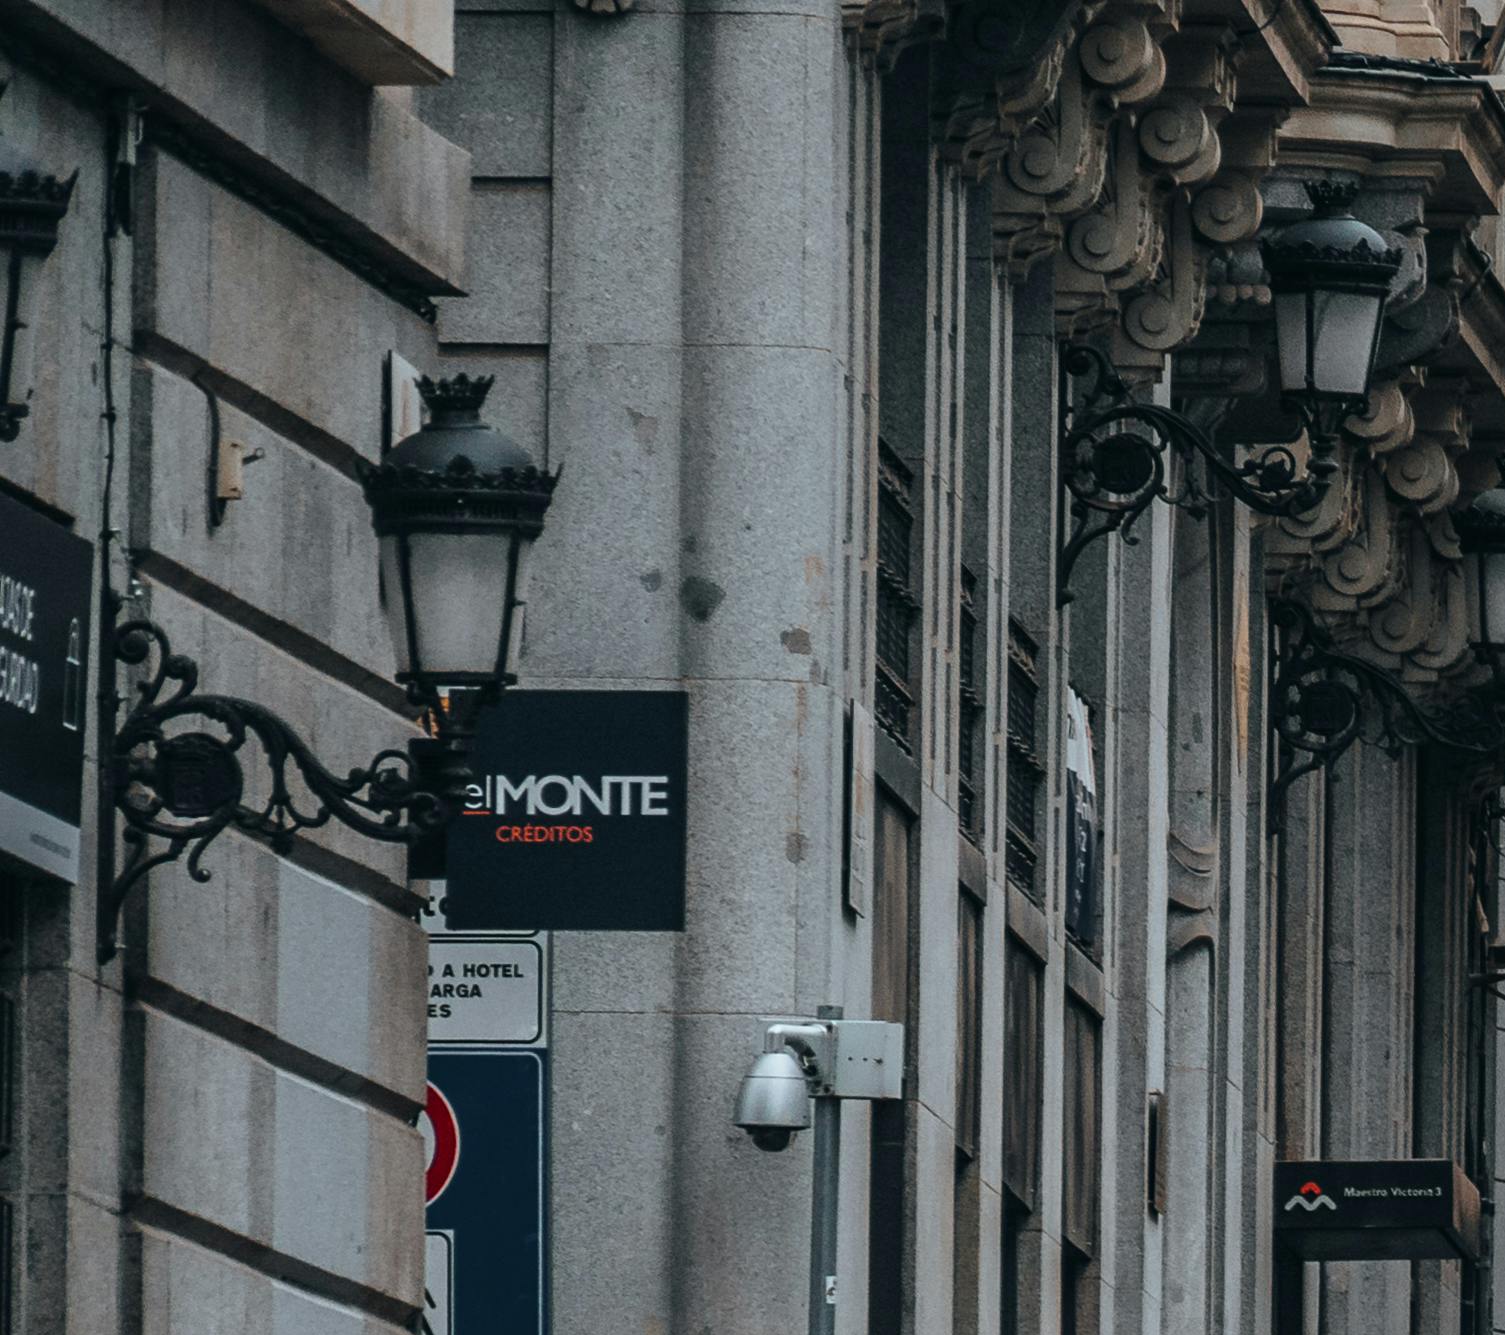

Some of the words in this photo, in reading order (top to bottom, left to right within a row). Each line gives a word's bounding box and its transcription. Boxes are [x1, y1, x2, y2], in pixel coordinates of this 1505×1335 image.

[495, 823, 594, 843] CRÉDITOS
[462, 963, 525, 979] HOTEL
[429, 983, 483, 999] ARGA
[427, 1005, 452, 1018] ES
[1343, 1187, 1388, 1198] Maestro
[1434, 1187, 1443, 1197] 3
